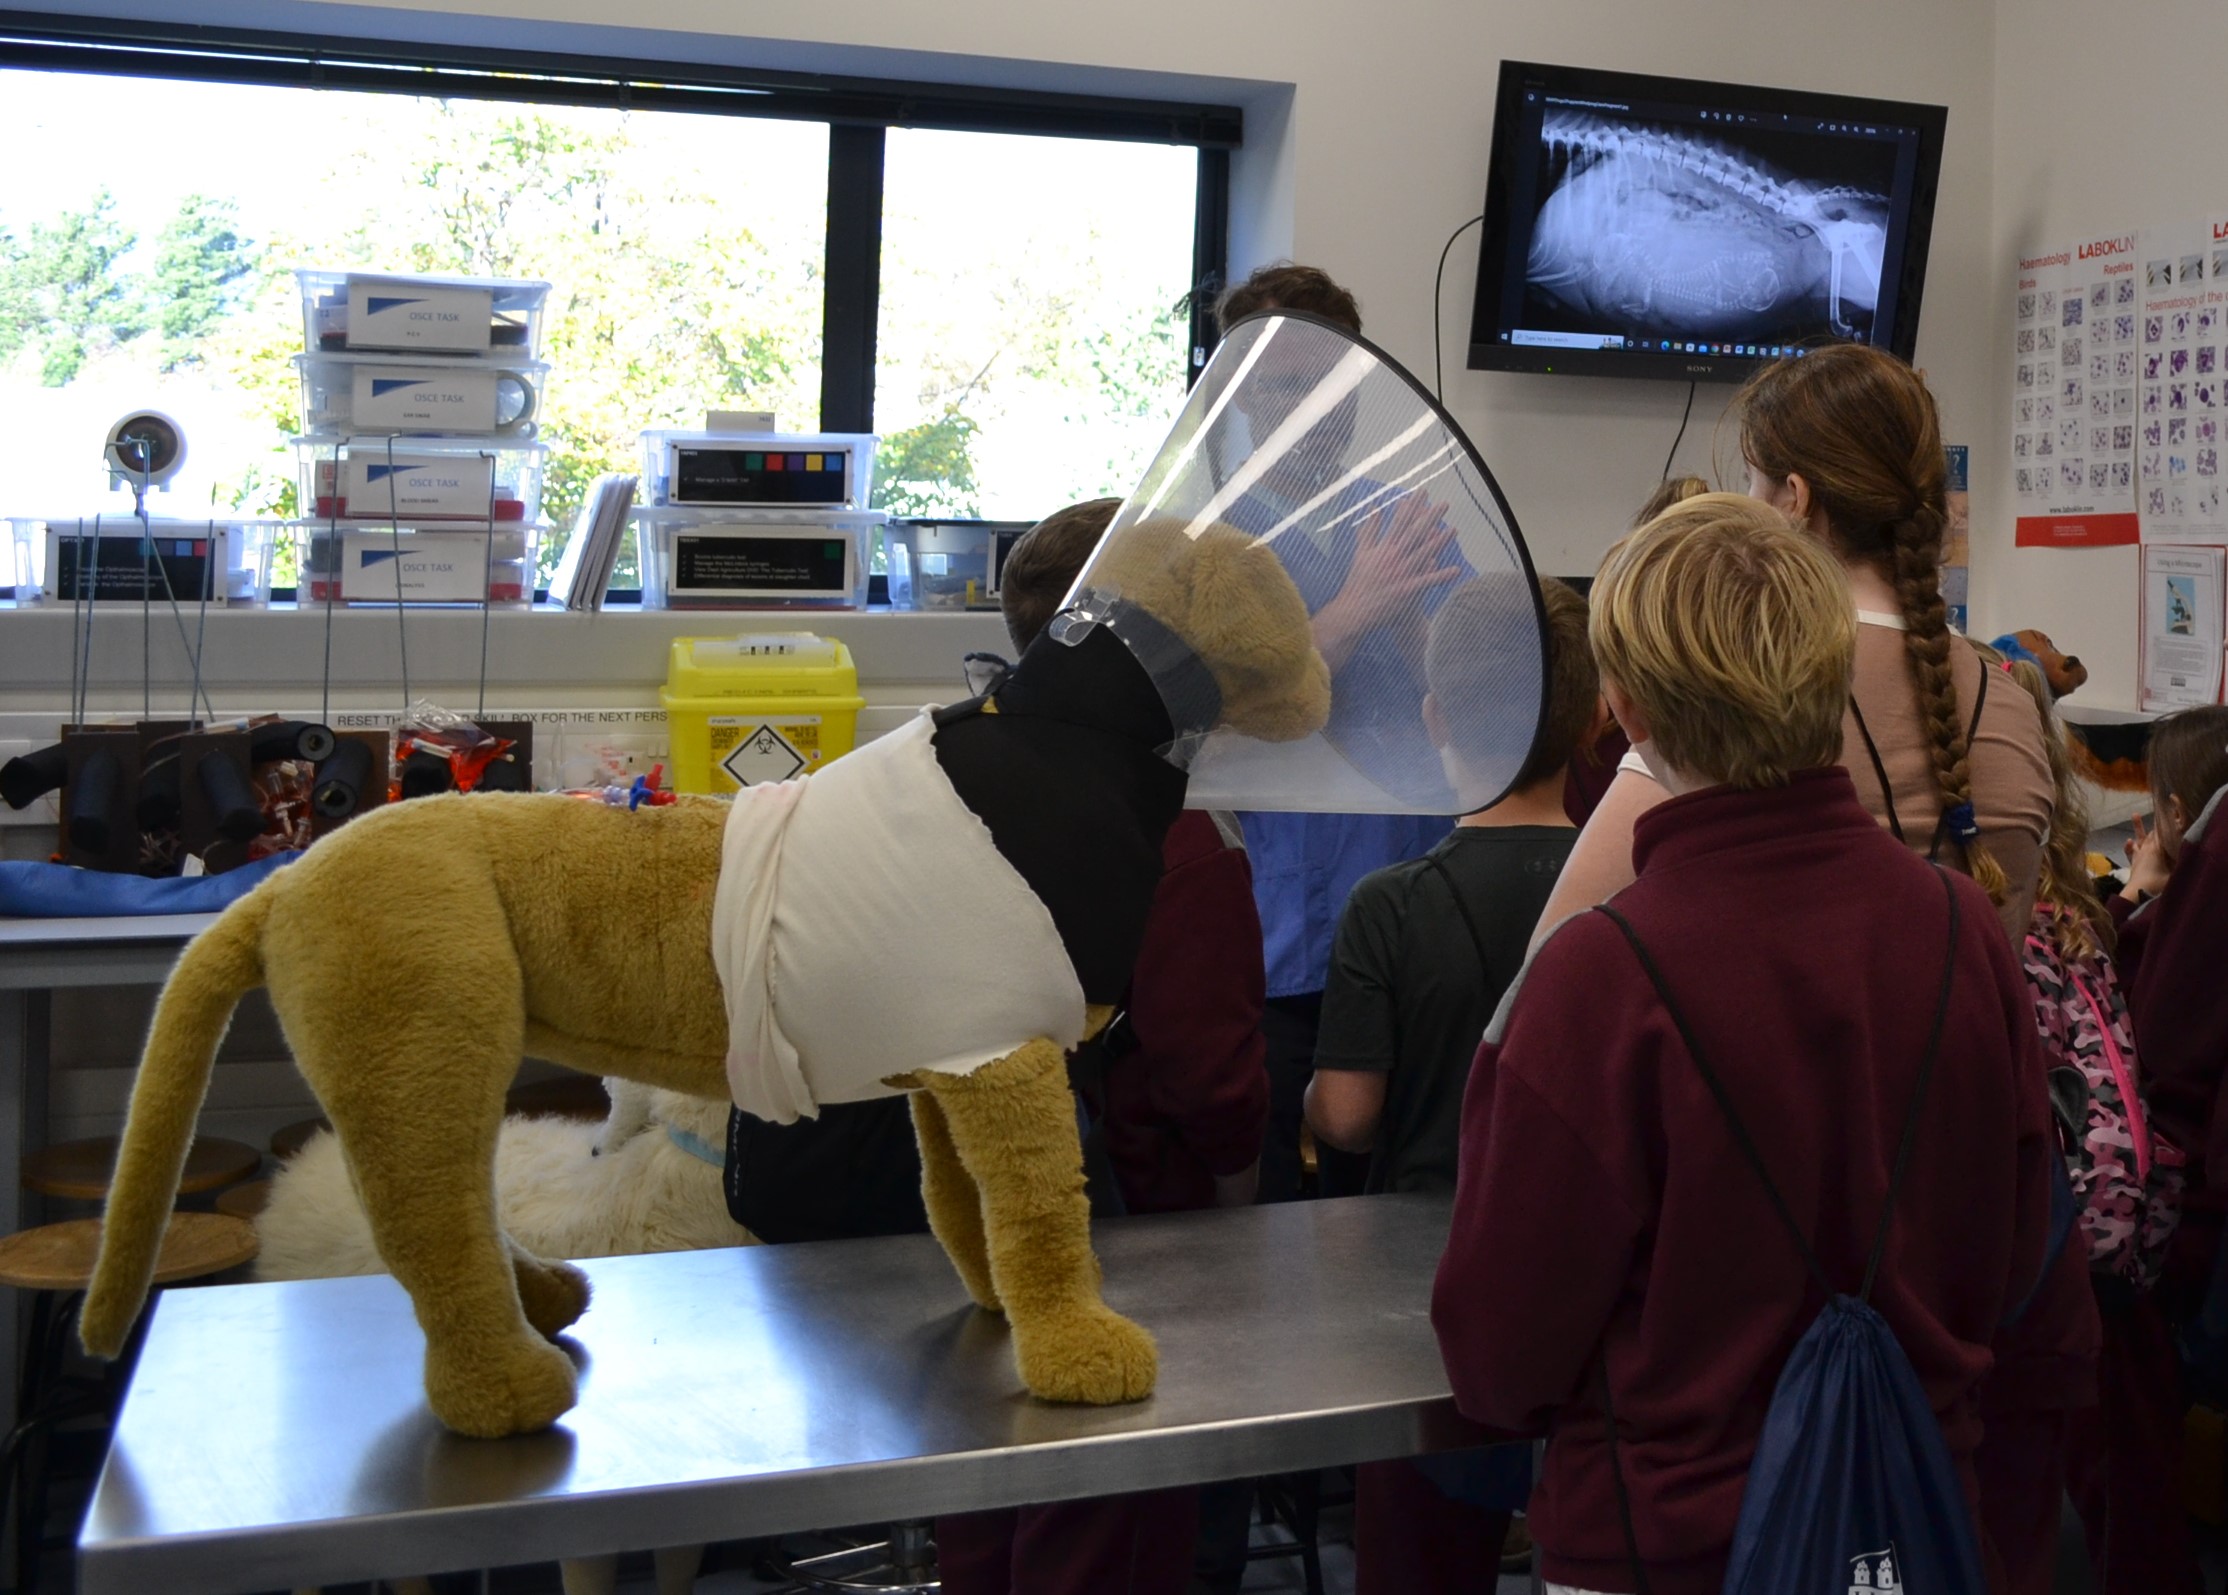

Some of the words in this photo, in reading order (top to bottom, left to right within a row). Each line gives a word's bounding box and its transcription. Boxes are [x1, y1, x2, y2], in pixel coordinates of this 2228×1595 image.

[2078, 237, 2135, 259] LABOKLIN
[2018, 252, 2072, 271] Haematology
[2103, 262, 2134, 276] Reptiles
[2018, 278, 2037, 290] Birds
[2145, 296, 2198, 312] Haematology
[2207, 290, 2222, 302] the
[409, 312, 433, 321] OSCE
[436, 312, 460, 322] TASK
[1686, 365, 1713, 373] SONY
[414, 393, 438, 402] OSCE
[441, 394, 465, 402] TASK
[409, 478, 434, 487] OSCE
[436, 479, 460, 488] TASK
[2049, 504, 2095, 514] www.laboklin.com
[403, 563, 427, 572] OSCE
[430, 563, 454, 572] TASK
[338, 715, 379, 726] RESET
[512, 713, 537, 722] BOX
[541, 713, 567, 723] FOR
[571, 712, 594, 722] THE
[599, 712, 631, 722] NEXT
[635, 711, 668, 721] PERS
[710, 727, 739, 738] DANGER
